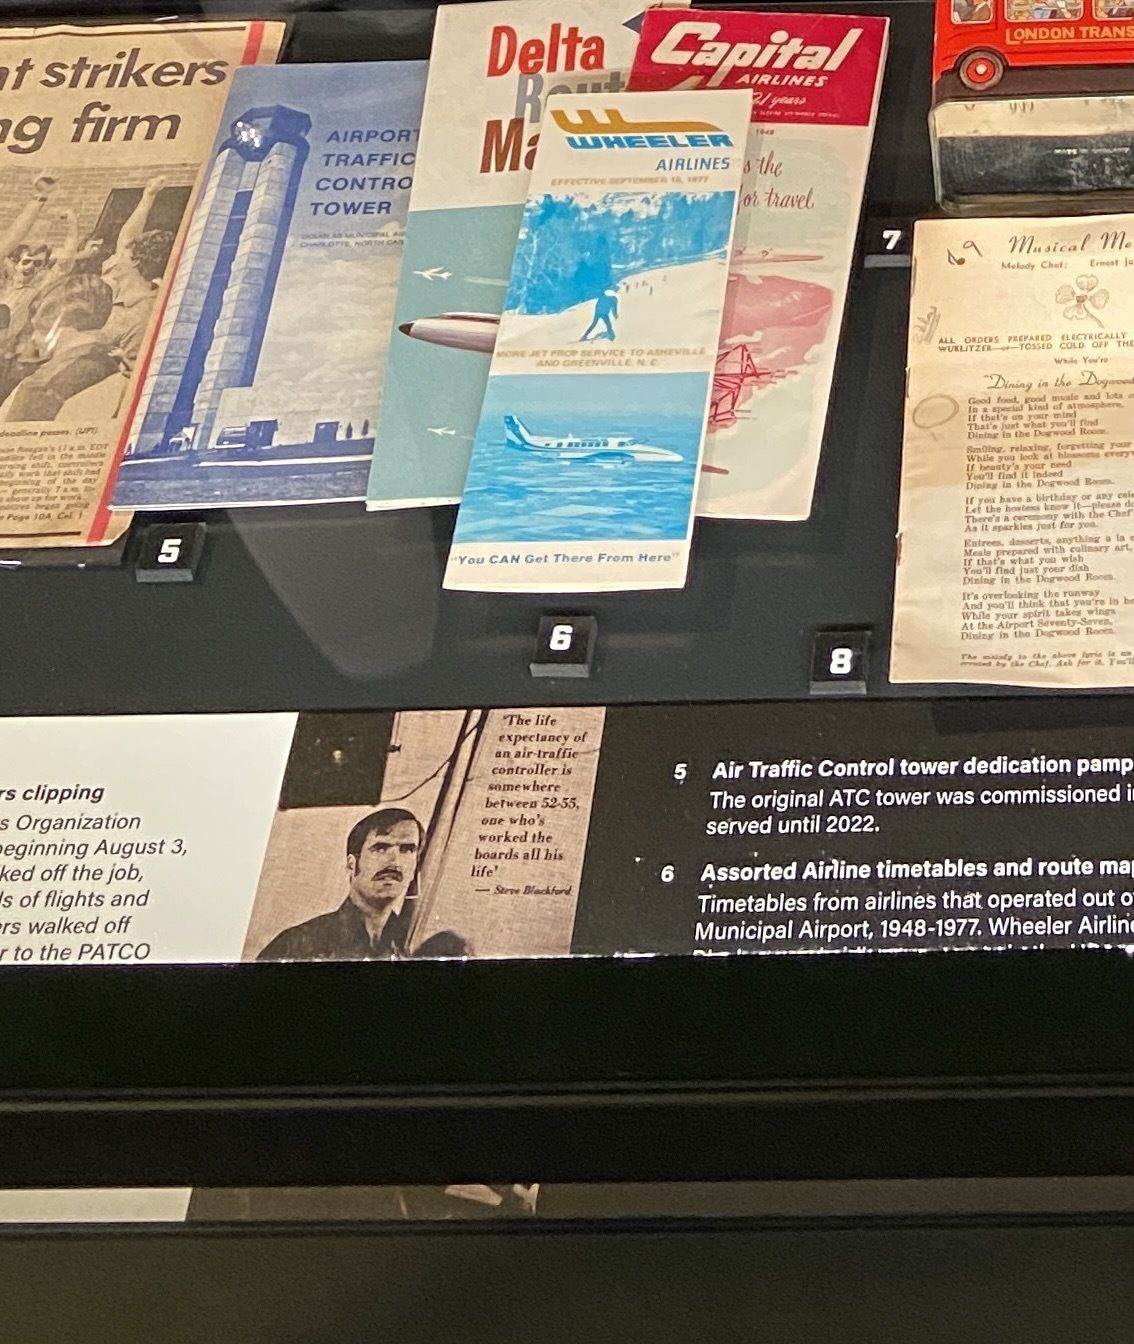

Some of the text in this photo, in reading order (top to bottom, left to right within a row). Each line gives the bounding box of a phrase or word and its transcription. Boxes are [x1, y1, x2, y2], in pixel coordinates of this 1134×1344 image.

[1005, 26, 1075, 45] LONDON
[487, 22, 605, 77] Delta
[651, 21, 863, 88] Capital
[39, 47, 229, 88] strikers
[736, 74, 828, 87] AIRLINES
[771, 95, 806, 109] years
[71, 101, 181, 142] firm
[566, 134, 734, 150] WHEELER
[322, 152, 416, 166] TRAFFIC
[656, 157, 730, 172] AIRLINES
[756, 150, 782, 176] the
[315, 176, 413, 191] CONTRO
[310, 201, 391, 215] TOWER
[765, 188, 815, 210] travel
[883, 230, 902, 249] 7
[1008, 233, 1091, 254] Musical
[158, 538, 182, 564] 5
[450, 552, 679, 565] "You CAN Get There From Here"
[550, 625, 572, 651] 6
[829, 648, 852, 674] 8
[534, 714, 557, 726] life
[498, 731, 588, 746] expectancy of
[494, 747, 579, 759] an air-traffic
[491, 763, 573, 775] controller is
[674, 763, 687, 781] 5
[712, 760, 744, 779] Air
[748, 759, 813, 778] Traffic
[818, 757, 894, 777] Control
[899, 758, 960, 775] tower
[963, 755, 1071, 774] dedication
[22, 784, 104, 803] clipping
[487, 779, 561, 792] somewhere
[484, 796, 580, 810] between 52-55,
[16, 812, 141, 834] Organization
[93, 839, 165, 859] August
[170, 838, 187, 856] 3,
[40, 863, 143, 885] off the job,
[661, 865, 674, 882] 6
[700, 861, 797, 881] Assorted
[801, 858, 871, 879] Airline
[876, 858, 988, 878] timetables
[993, 857, 1032, 876] and
[1038, 855, 1094, 876] route
[19, 889, 150, 912] of flights and
[28, 915, 133, 934] walked off
[13, 942, 151, 961] to the PATCO
